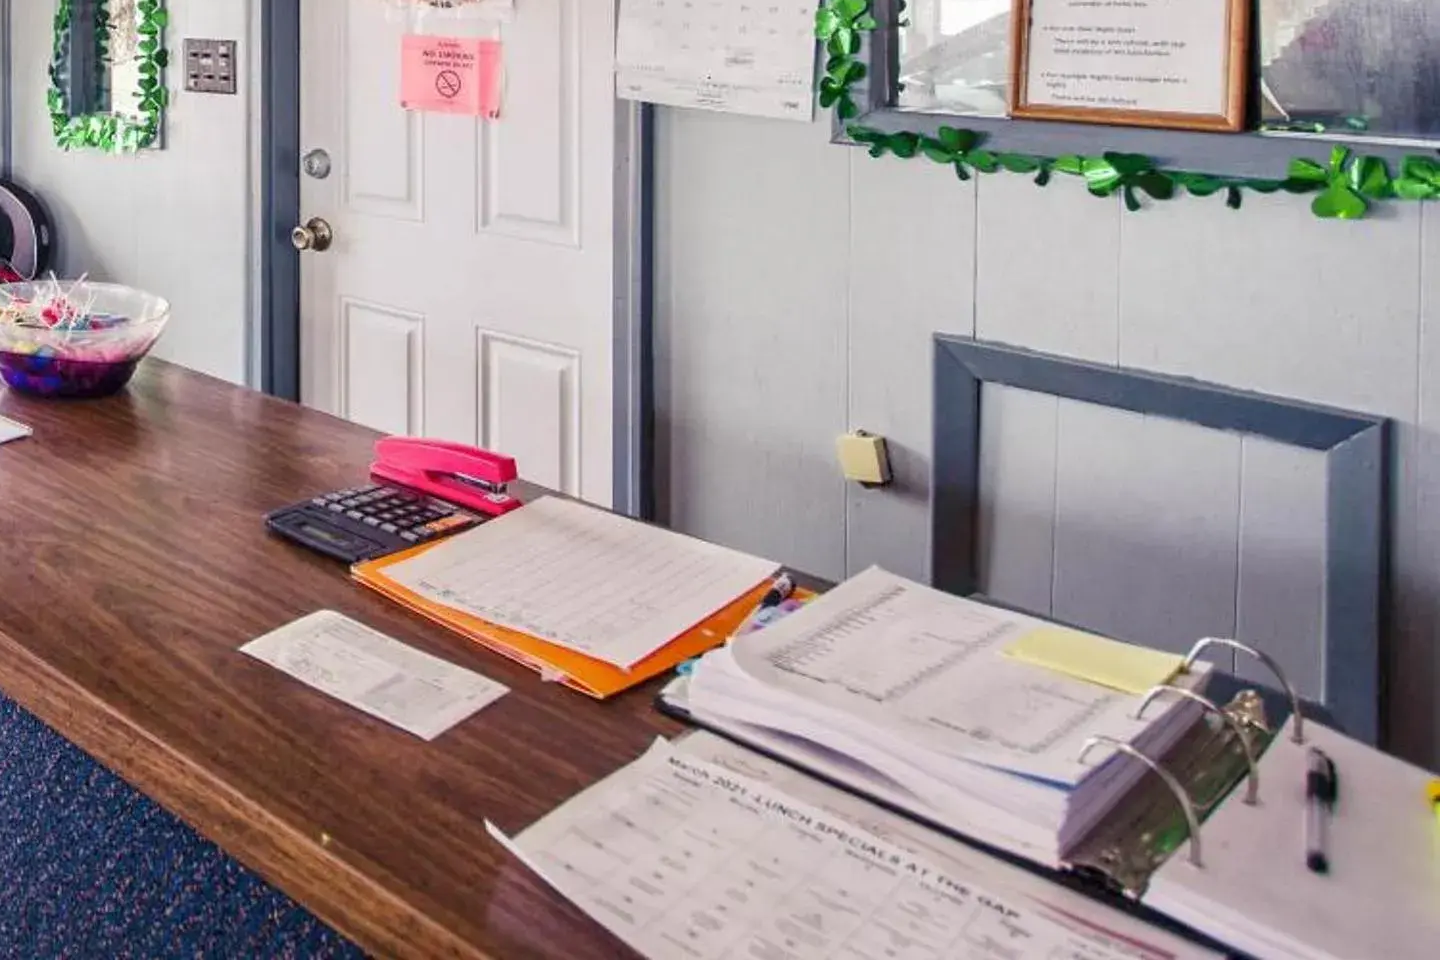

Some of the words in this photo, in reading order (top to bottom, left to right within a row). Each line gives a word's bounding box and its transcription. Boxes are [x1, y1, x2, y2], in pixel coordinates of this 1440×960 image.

[713, 774, 748, 797] 2021
[814, 820, 902, 867] SPECIALS
[905, 860, 930, 878] AT
[937, 874, 971, 899] THE
[978, 894, 1021, 921] GAP
